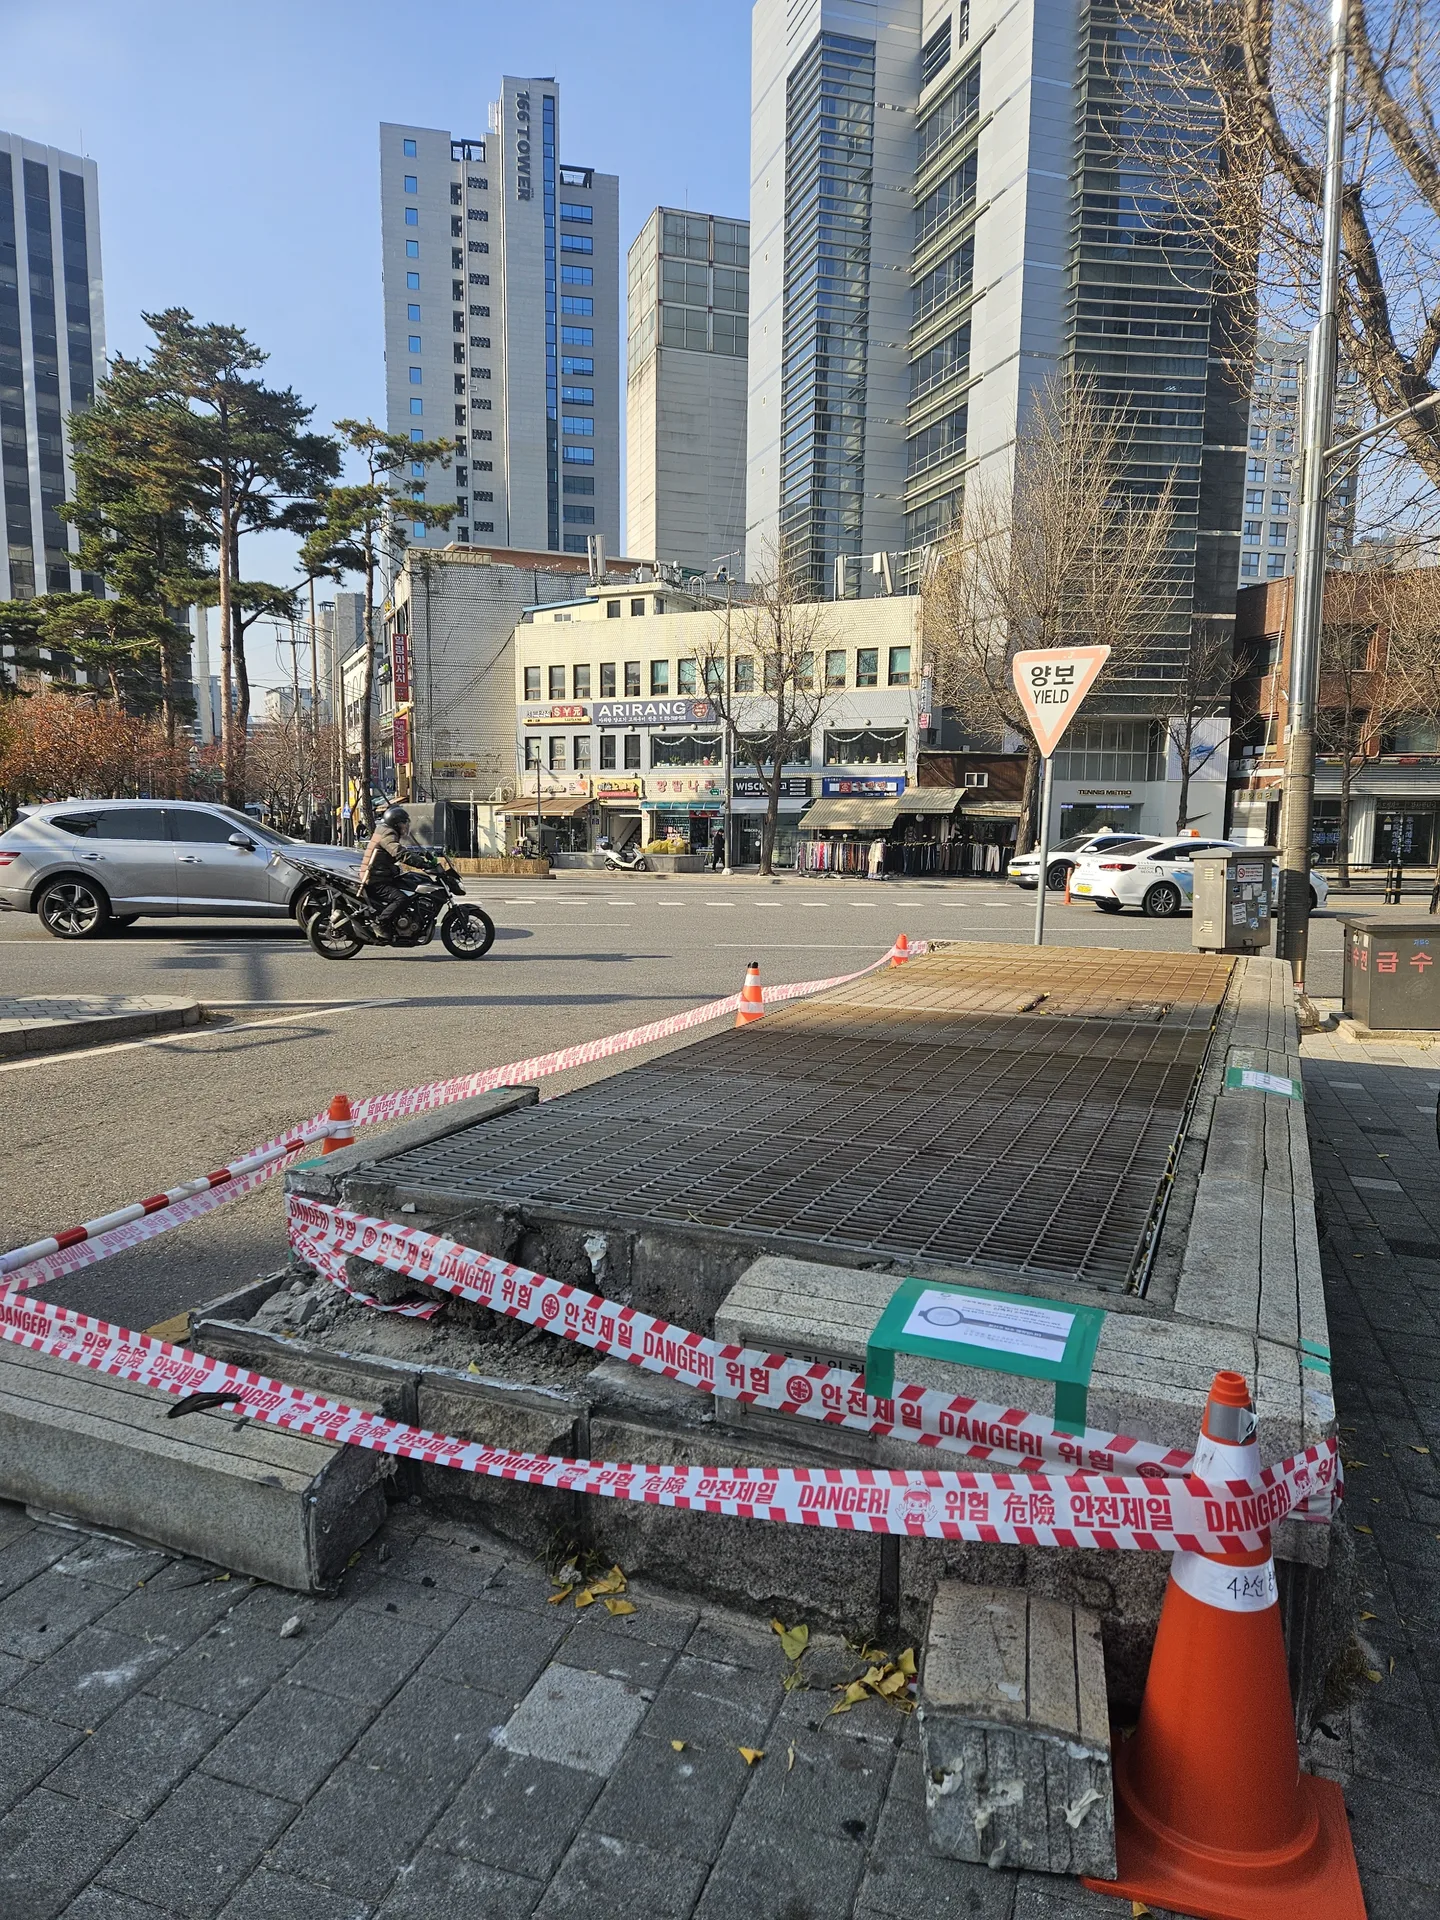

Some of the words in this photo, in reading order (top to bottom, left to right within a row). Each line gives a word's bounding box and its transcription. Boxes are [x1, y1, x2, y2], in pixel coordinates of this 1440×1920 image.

[516, 90, 530, 123] 166
[517, 125, 531, 201] TOWER
[1031, 664, 1075, 687] 양보
[599, 702, 686, 717] ARIRANG
[1033, 689, 1070, 704] YIELD
[289, 1199, 330, 1231] DANGER!
[334, 1216, 357, 1241] 위험
[381, 1232, 434, 1271] 안전제일
[438, 1255, 497, 1294] DANGER!
[501, 1280, 533, 1309] 위험
[564, 1302, 633, 1350] 안전제일
[643, 1331, 714, 1380] DANGER!
[725, 1361, 770, 1395] 위험
[820, 1383, 922, 1431] 안전제일
[939, 1412, 1043, 1458] DANGER!
[1058, 1441, 1114, 1474] 위험
[82, 1331, 112, 1358] 위험
[111, 1343, 148, 1370] 危險
[147, 1355, 210, 1388] 안전제일
[313, 1410, 351, 1429] 위험
[393, 1431, 465, 1458] 안전제일
[476, 1451, 557, 1476] DANGER!
[596, 1470, 637, 1488] 위험
[641, 1476, 687, 1495] 危險
[695, 1478, 778, 1506] 안전제일
[798, 1485, 891, 1515] DANGER!
[944, 1490, 989, 1522] 위험
[1003, 1491, 1056, 1526] 危險
[1071, 1494, 1174, 1532] 안전제일
[1205, 1478, 1291, 1533] DANGER!
